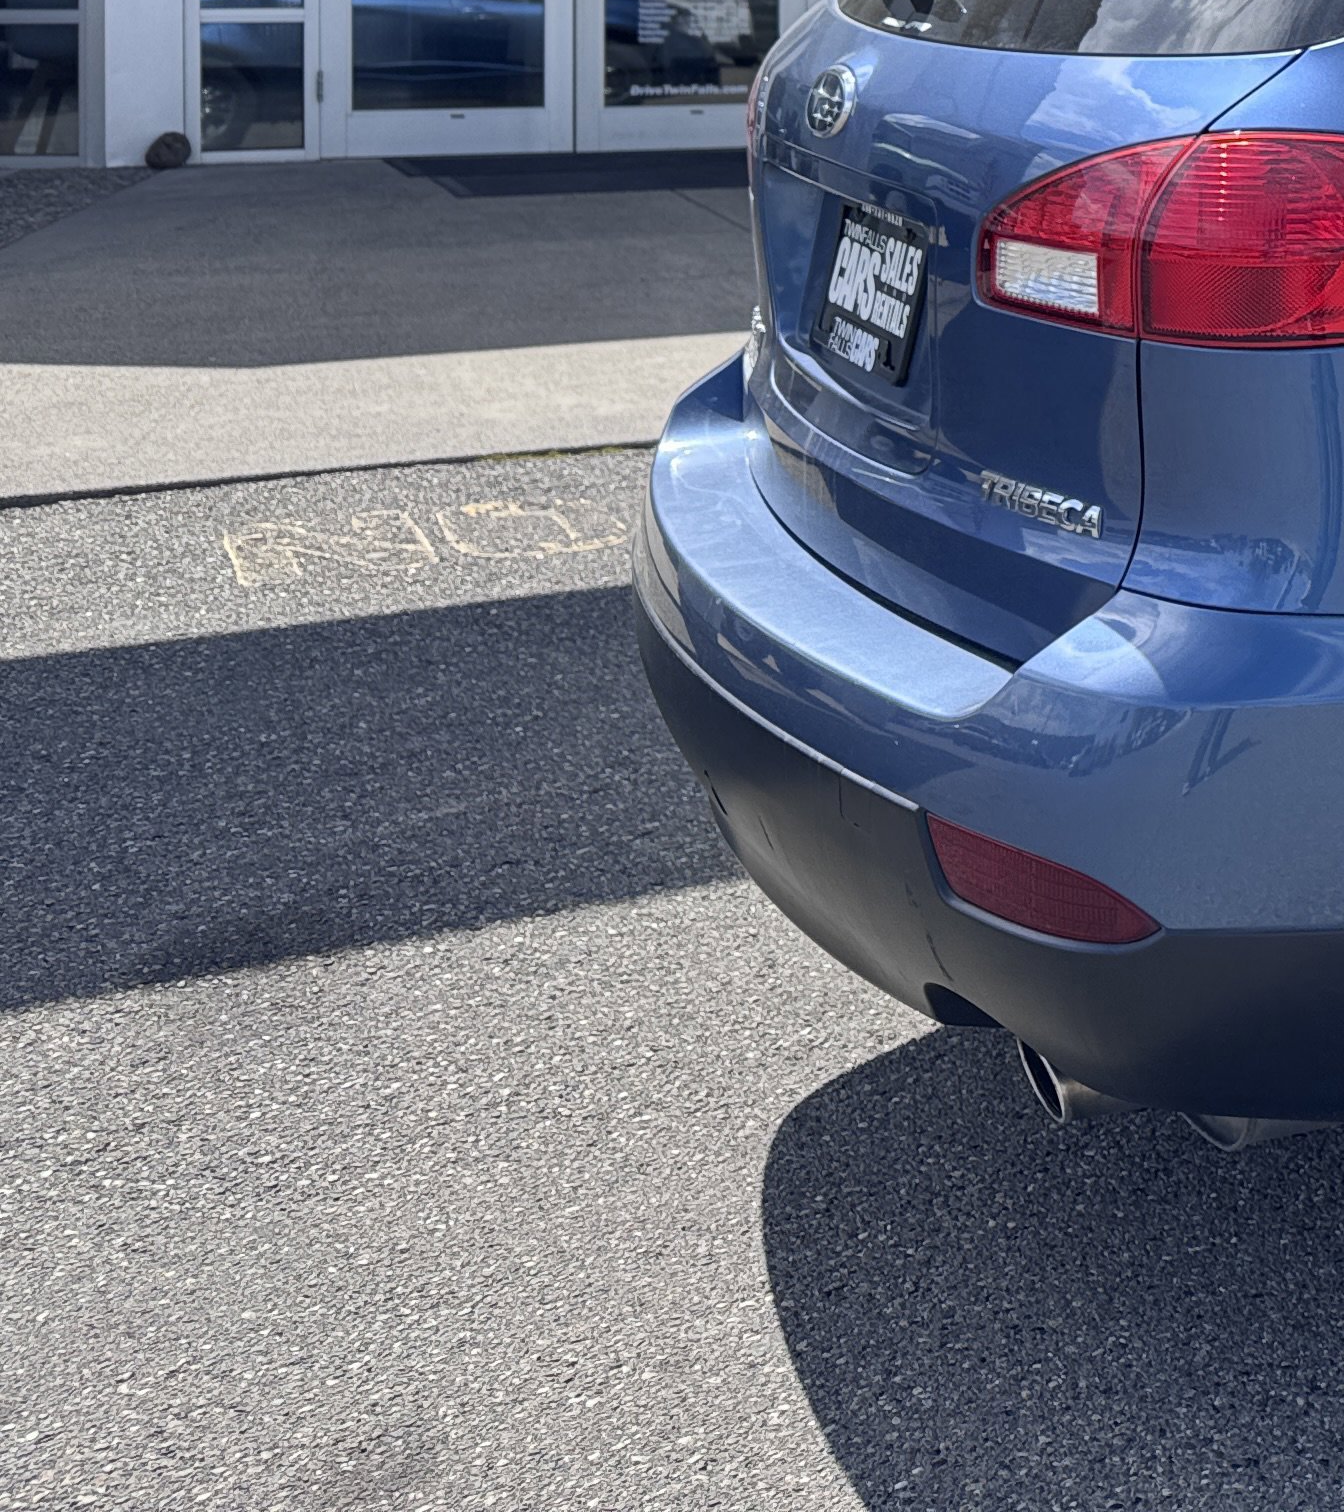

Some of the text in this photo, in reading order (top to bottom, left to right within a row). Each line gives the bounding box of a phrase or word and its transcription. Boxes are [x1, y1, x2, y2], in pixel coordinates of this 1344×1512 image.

[828, 236, 882, 321] CARS
[880, 237, 923, 296] SALES
[833, 316, 858, 342] TWIN
[870, 290, 910, 339] RENTALS
[828, 337, 852, 362] FALLS
[850, 327, 879, 372] CARS
[979, 469, 1102, 539] TRIBECA
